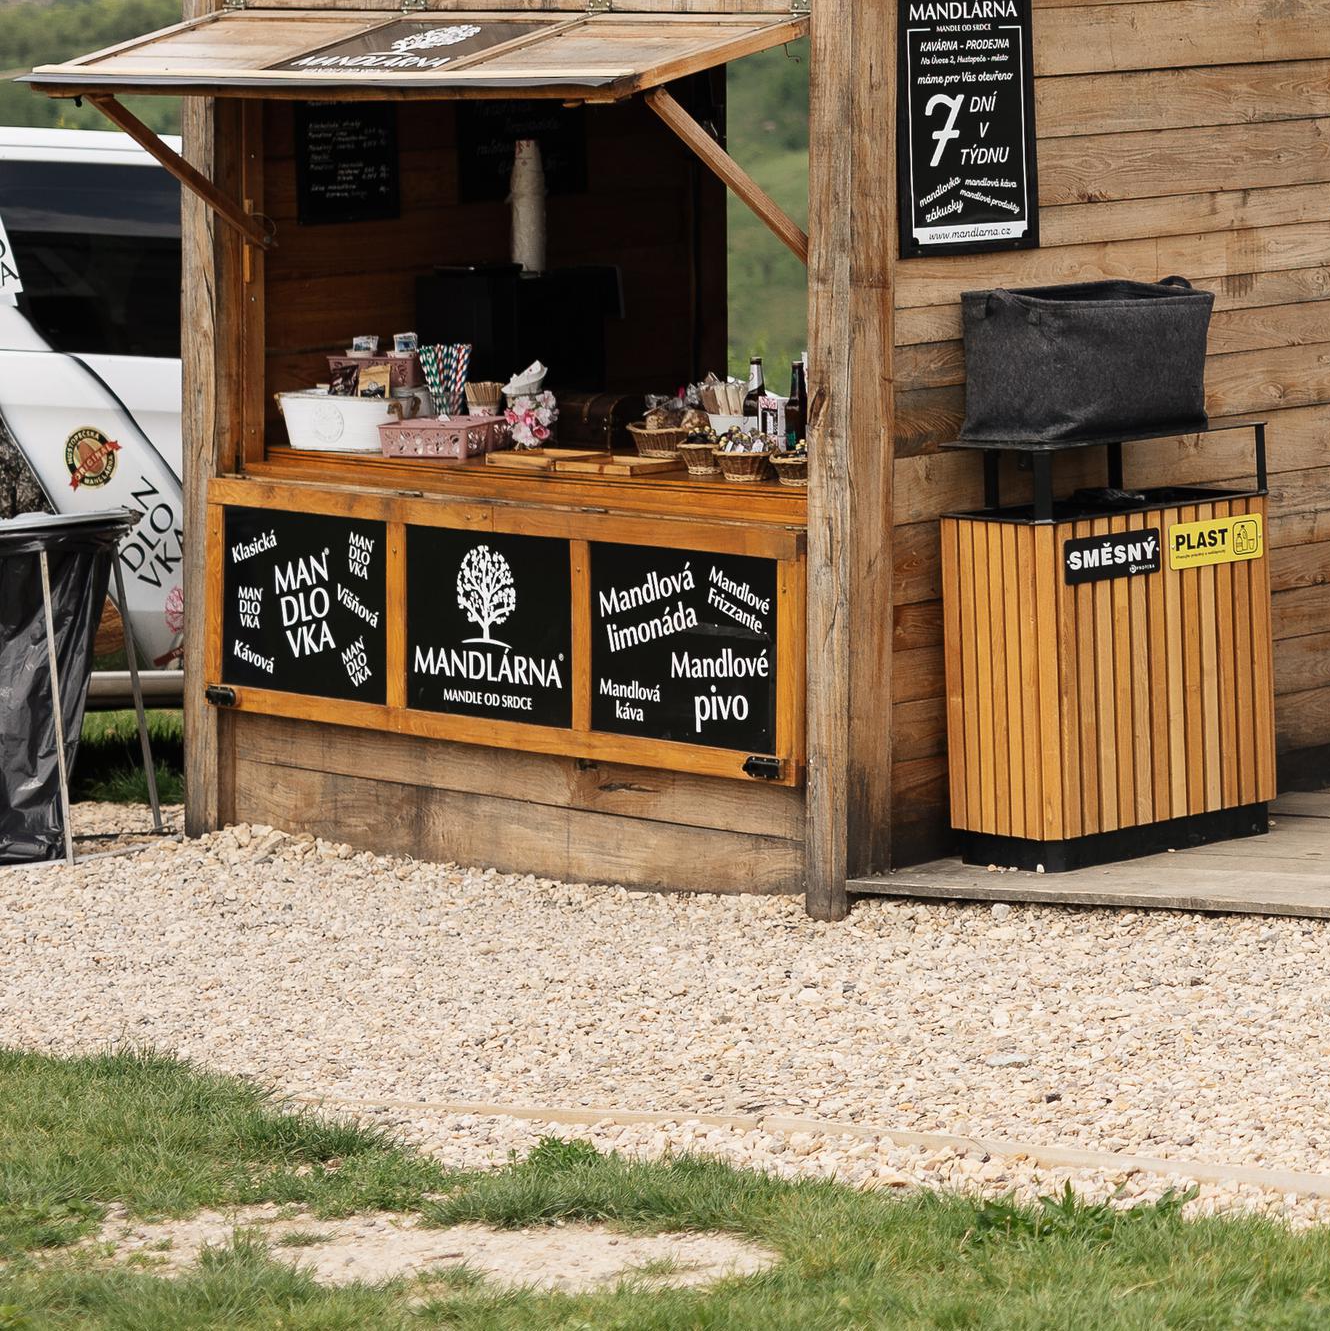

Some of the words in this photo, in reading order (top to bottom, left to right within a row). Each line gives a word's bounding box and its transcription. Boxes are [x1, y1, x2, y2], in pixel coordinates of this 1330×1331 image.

[936, 24, 961, 33] MANDLE
[962, 24, 972, 32] OD
[972, 23, 992, 31] SRDCE
[920, 39, 958, 52] KAVÁRNA
[966, 38, 1010, 50] PRODEJNA
[917, 73, 944, 85] máme
[944, 74, 960, 86] pro
[961, 71, 977, 83] Vás
[978, 70, 1014, 82] otevřeno
[969, 90, 998, 113] DNÍ
[925, 93, 965, 167] 7
[979, 122, 989, 138] V
[960, 144, 1010, 166] TÝDNU
[919, 176, 961, 208] mandlovka
[965, 178, 999, 188] mandlová
[1000, 178, 1018, 188] káva
[925, 199, 964, 222] zákusky
[929, 227, 1012, 241] www.mandlarna.cz
[74, 443, 113, 480] ORIGINAL
[119, 503, 174, 573] DLO
[231, 529, 278, 563] Klasická
[1175, 528, 1228, 552] PLAST
[348, 545, 371, 566] DLO
[1069, 536, 1156, 571] SMĚSNÝ
[348, 559, 368, 580] VKA
[599, 561, 696, 618] Mandlová
[708, 565, 771, 615] Mandlové
[239, 600, 261, 615] DLO
[280, 587, 330, 627] DLO
[337, 583, 380, 628] Višňová
[707, 587, 763, 634] Frizzante
[240, 614, 260, 629] VKA
[606, 601, 698, 653] limonáda
[286, 620, 336, 658] VKA
[234, 639, 275, 674] Kávová
[346, 652, 368, 677] DLO
[414, 645, 563, 689] MANDLÁRNA
[671, 648, 769, 678] Mandlové
[350, 666, 373, 688] VKA
[443, 688, 483, 705] MANDLE
[484, 693, 500, 707] OD
[501, 695, 533, 711] SRDCE
[599, 678, 661, 703] Mandlová
[615, 700, 644, 722] káva
[694, 684, 749, 733] pivo
